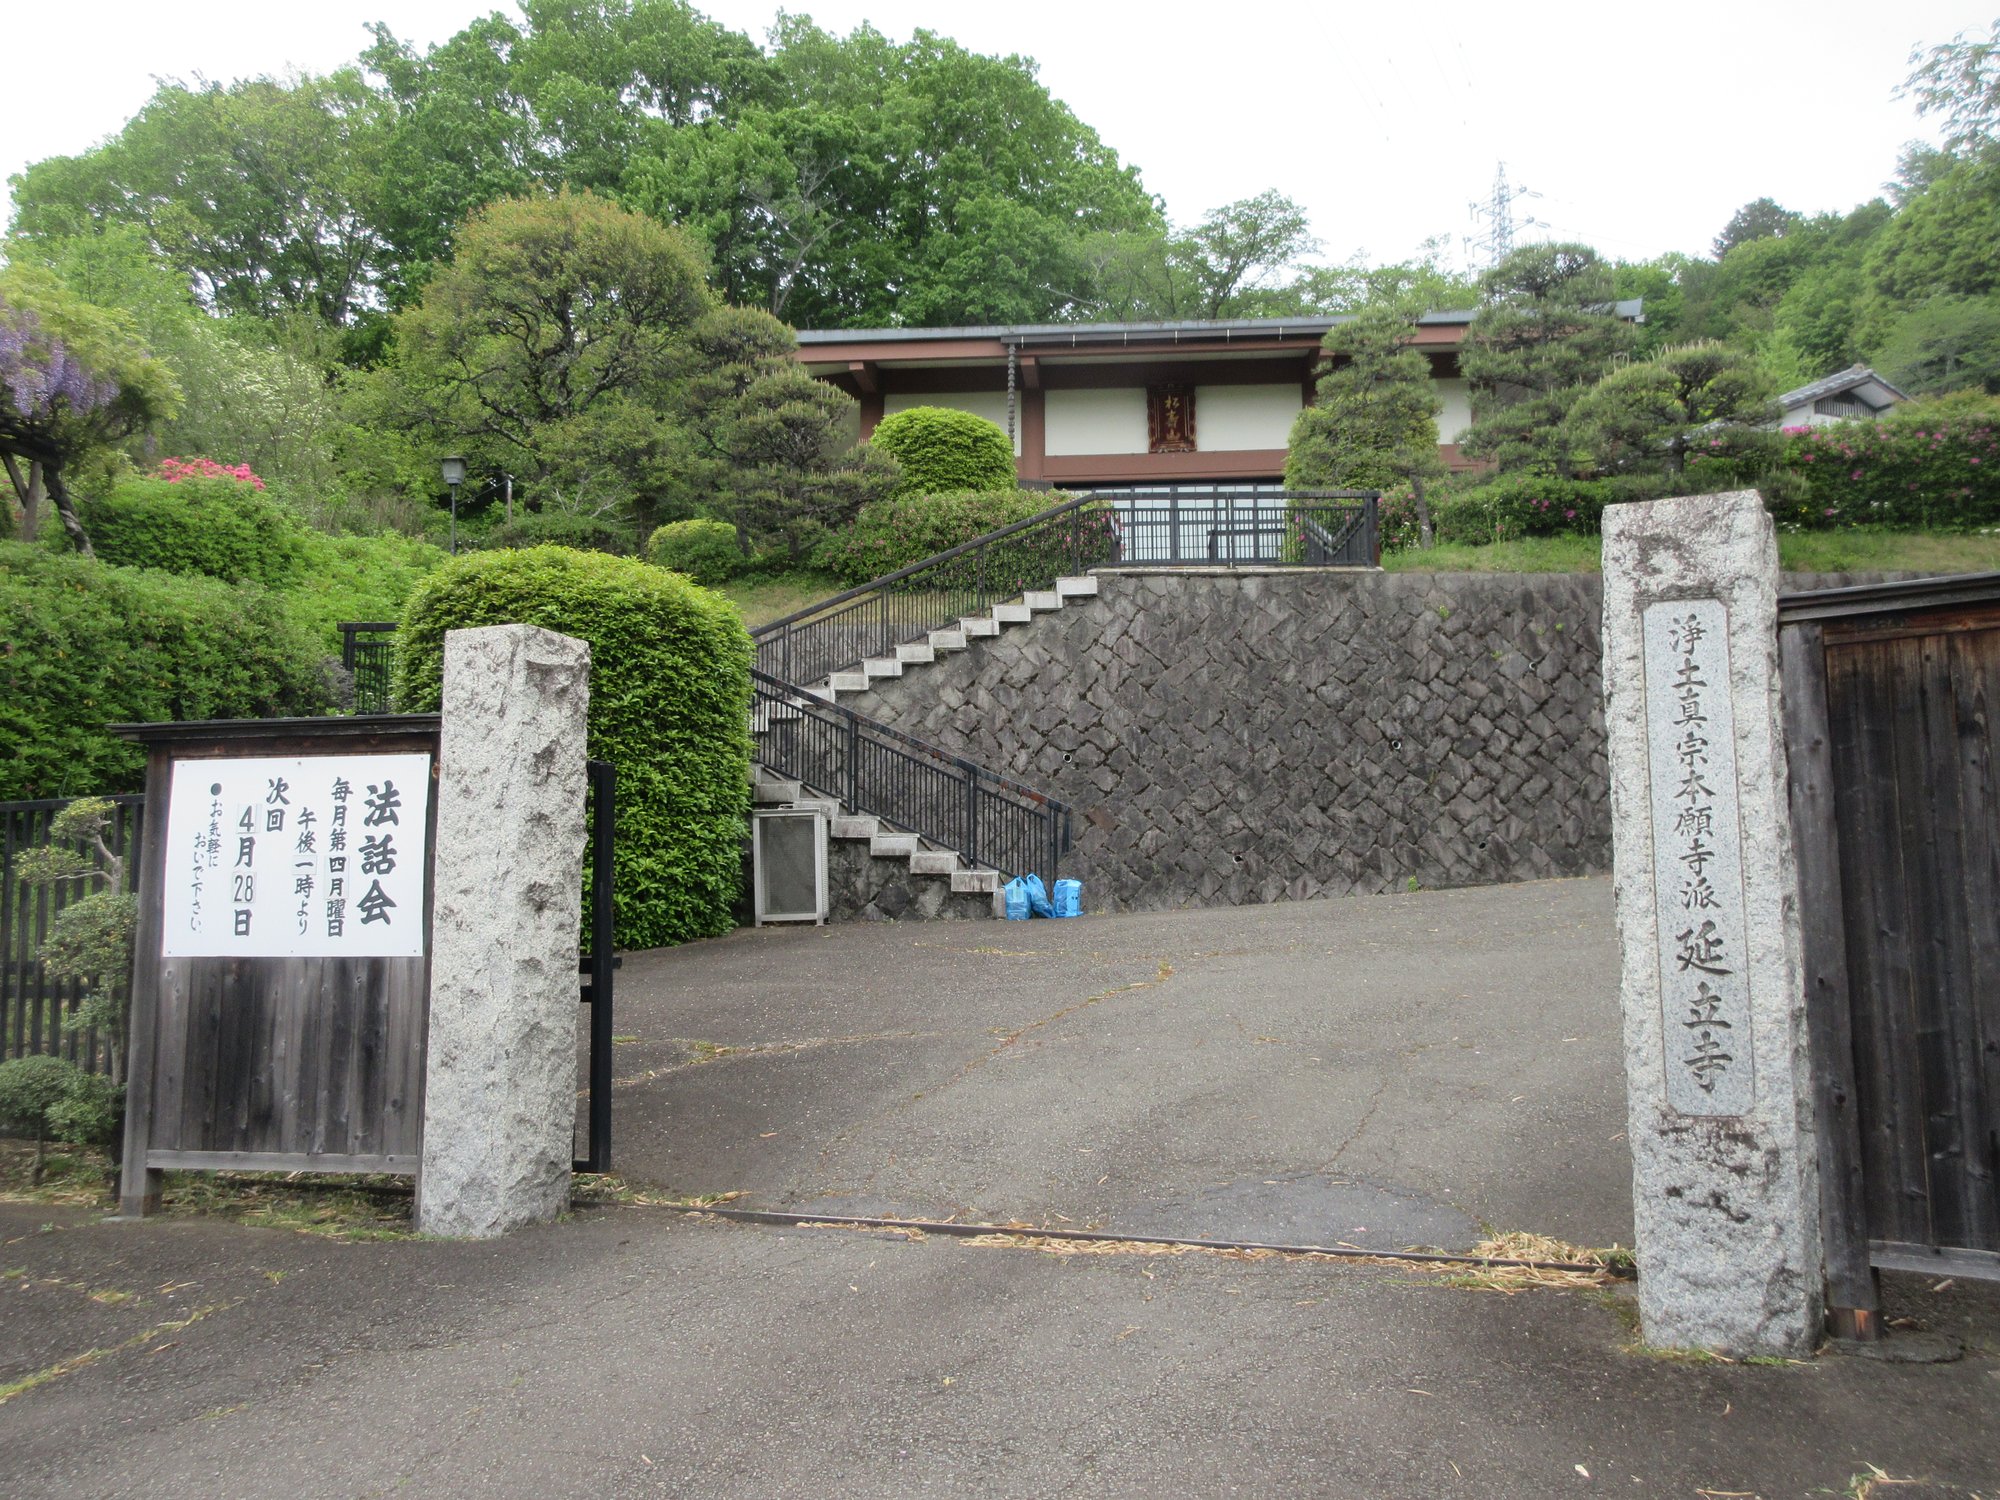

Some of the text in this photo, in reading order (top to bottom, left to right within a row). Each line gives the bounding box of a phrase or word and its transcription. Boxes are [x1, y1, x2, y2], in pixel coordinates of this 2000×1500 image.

[265, 777, 291, 833] 次回
[326, 776, 353, 938] 毎月第四月曜日
[356, 780, 402, 926] 法話会
[190, 831, 207, 932] おいで下さい
[293, 806, 318, 936] 午後一時より
